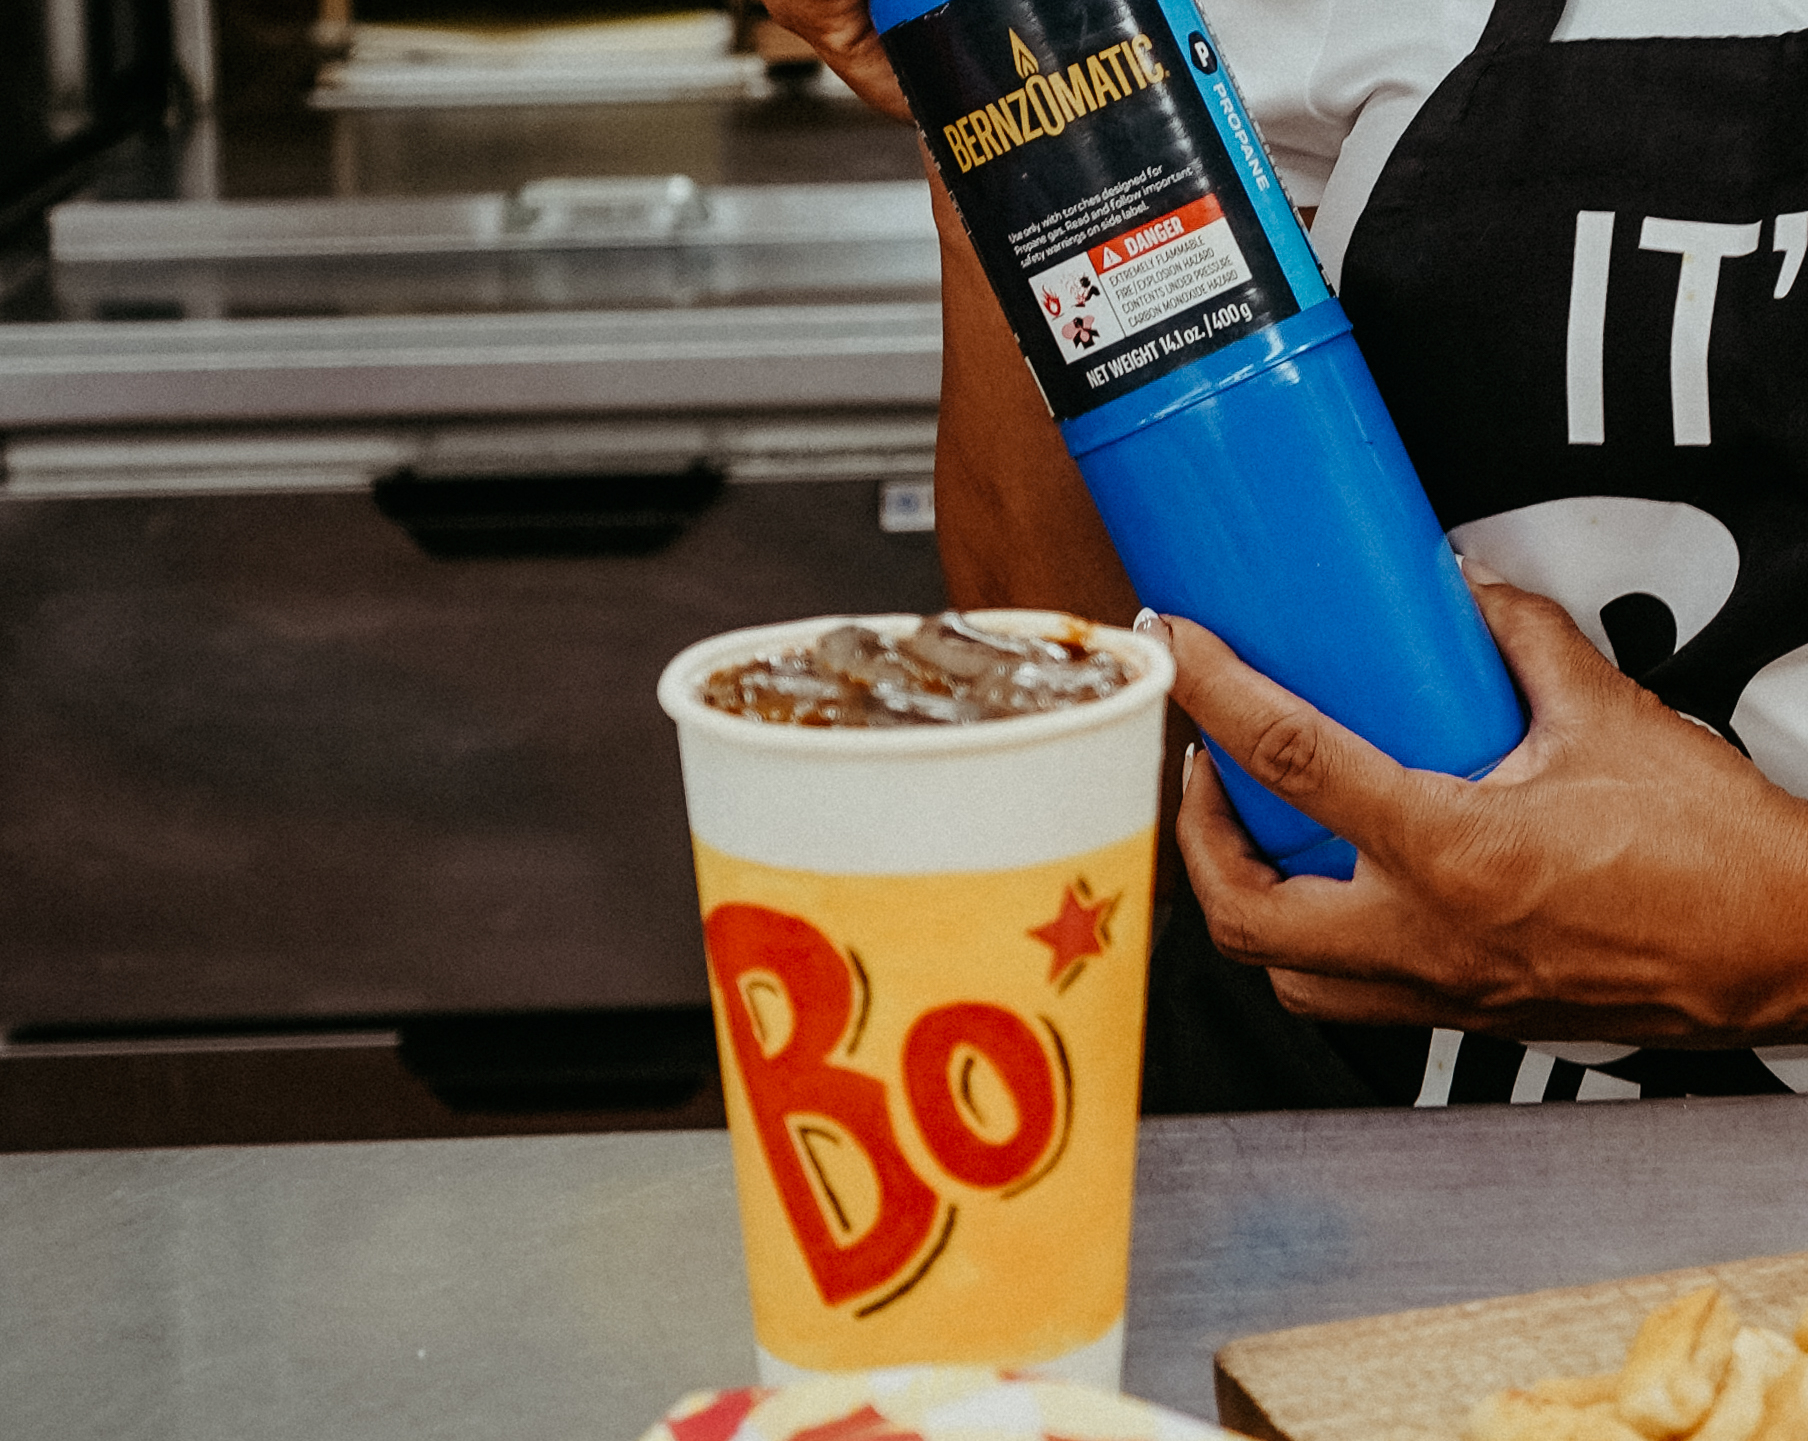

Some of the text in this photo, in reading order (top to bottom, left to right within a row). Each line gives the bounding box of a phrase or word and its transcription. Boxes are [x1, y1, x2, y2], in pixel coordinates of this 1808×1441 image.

[942, 33, 1168, 174] BERNZOMATIC
[1213, 82, 1269, 191] PROPANE
[1014, 235, 1047, 255] Propane
[1065, 212, 1090, 230] Read
[1091, 202, 1110, 220] and
[1110, 190, 1143, 211] follow
[1142, 166, 1194, 195] important
[1041, 212, 1062, 227] with
[1062, 194, 1101, 218] torches
[1102, 169, 1147, 202] designed
[1147, 165, 1162, 178] for
[1021, 251, 1045, 268] safety
[1046, 232, 1086, 256] warnings
[1087, 225, 1100, 237] on
[1101, 214, 1122, 230] side
[1109, 236, 1205, 287] EXTREMELY FLAMMABLE
[1124, 217, 1184, 257] DANGER
[1183, 248, 1214, 269] HAZARD
[1122, 255, 1232, 314] CONTENTS UNDER PRESSURE
[1128, 270, 1238, 327] CARBON MONOXIDE HAZARD
[1086, 364, 1109, 388] NET
[1108, 341, 1159, 378] WEIGHT
